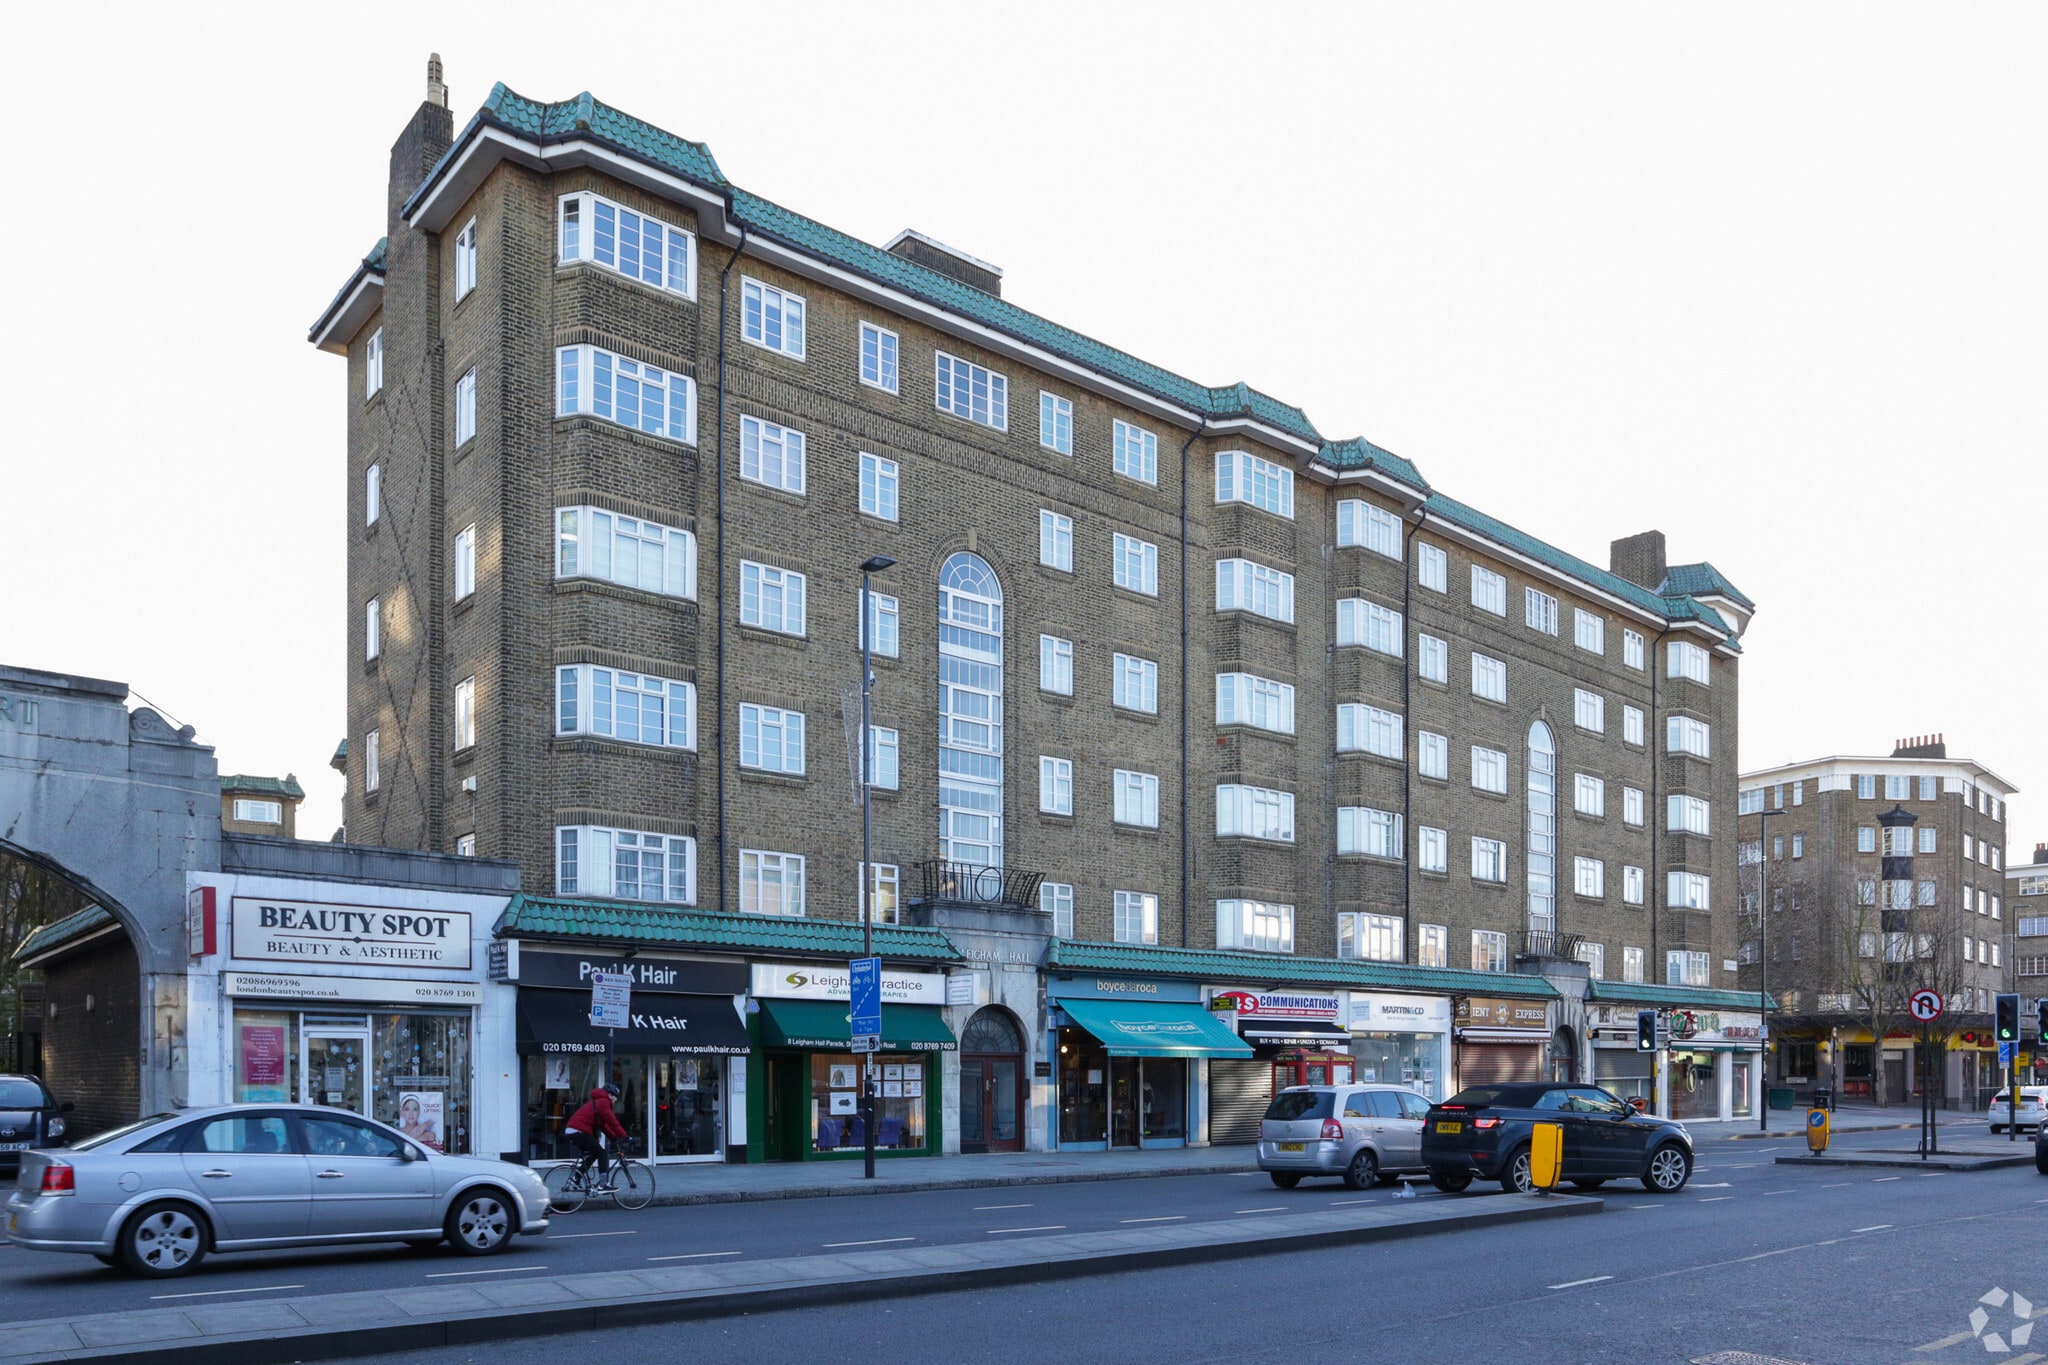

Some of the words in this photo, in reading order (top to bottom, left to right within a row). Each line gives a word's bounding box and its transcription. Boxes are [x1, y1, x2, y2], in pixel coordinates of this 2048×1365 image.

[259, 906, 376, 933] BEAUTY
[382, 914, 450, 938] SPOT
[267, 941, 332, 956] BEAUTY
[340, 946, 350, 956] &
[359, 946, 442, 960] AESTHETIC
[1009, 952, 1031, 962] HALL
[623, 964, 636, 983] K
[640, 964, 678, 984] Hair
[236, 977, 300, 987] 02086969596
[812, 974, 850, 988] Leigh
[881, 980, 922, 990] ractice
[236, 986, 340, 998] londonbeautyspot.co.uk
[1260, 996, 1339, 1009] COMMUNICATIONS
[1472, 1007, 1490, 1017] IENT
[1515, 1009, 1544, 1019] EXPRESS
[632, 1014, 648, 1028] K
[649, 1015, 688, 1030] Hair
[543, 1043, 560, 1052] 020
[561, 1044, 582, 1052] 8769
[584, 1044, 605, 1052] 4803
[672, 1045, 750, 1054] www.paulkhair.co.uk
